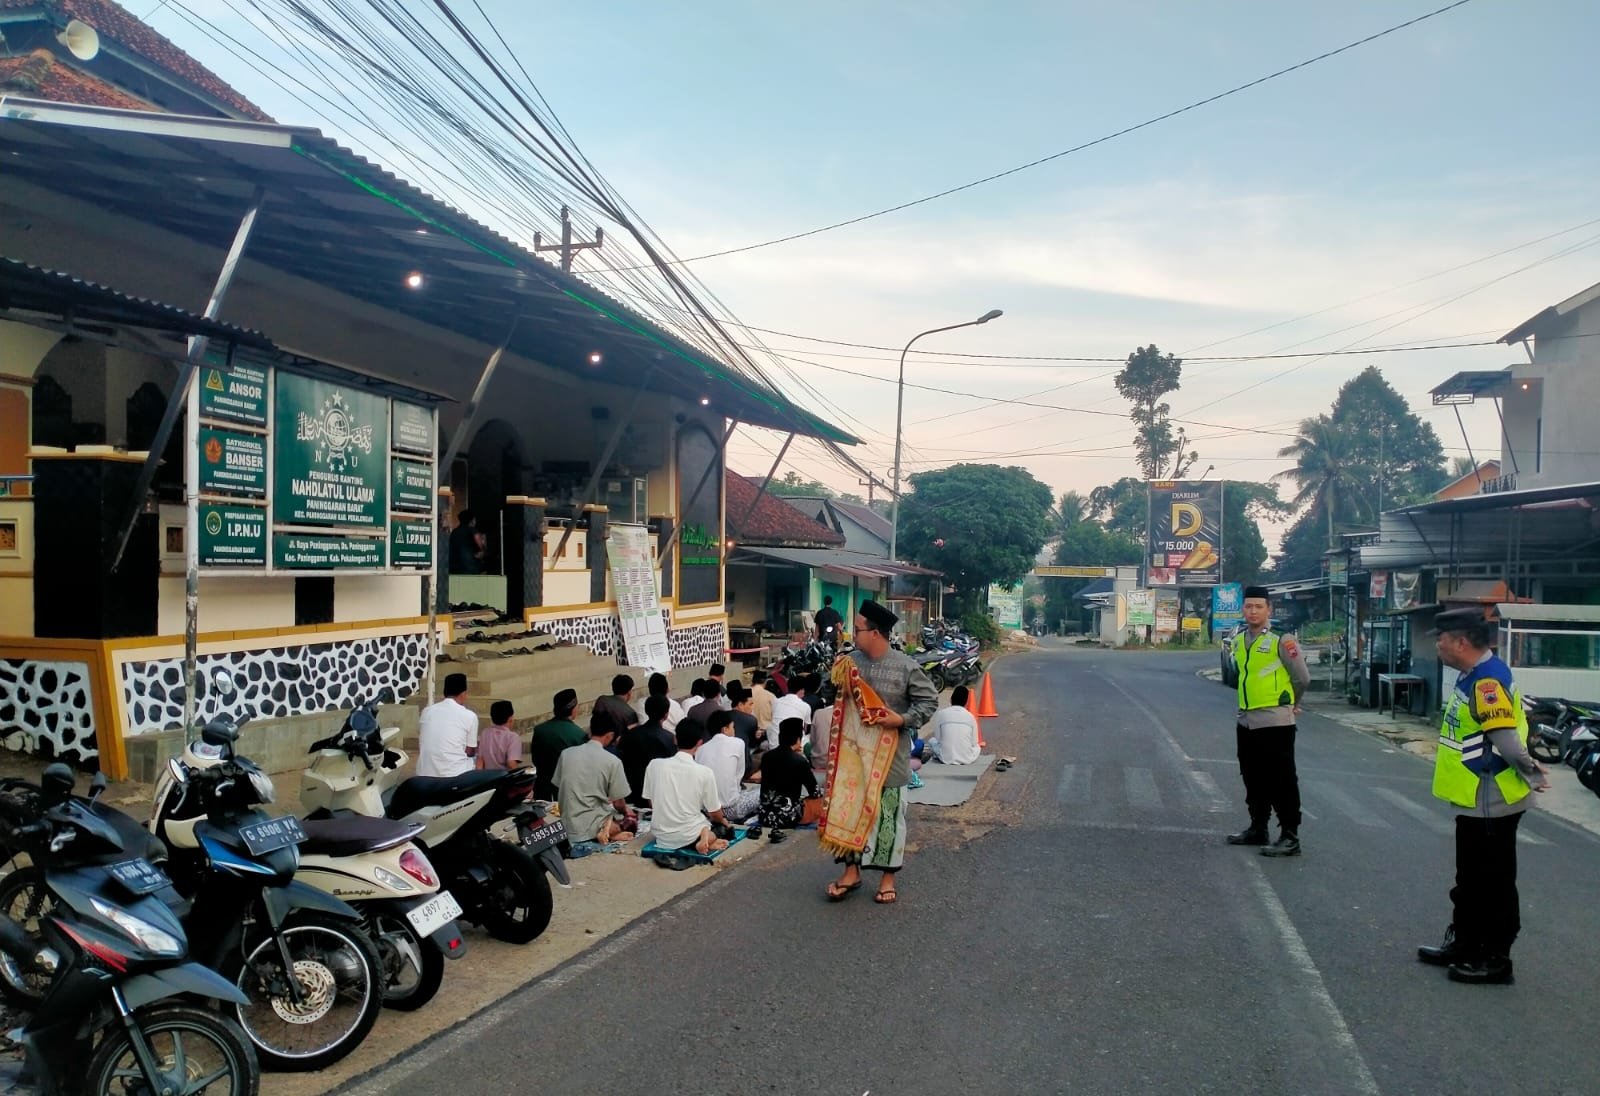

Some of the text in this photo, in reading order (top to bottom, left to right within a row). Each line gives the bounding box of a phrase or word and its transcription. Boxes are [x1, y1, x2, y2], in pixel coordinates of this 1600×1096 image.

[230, 382, 262, 399] ANSOR
[226, 452, 263, 468] BANSER
[315, 450, 358, 467] N U
[309, 470, 339, 482] PENGURUS
[292, 478, 344, 499] NAHDLATUL
[307, 499, 364, 512] PANINGGARAN BARAT
[1171, 501, 1203, 537] D
[228, 523, 260, 537] I.P.N.U
[1165, 541, 1194, 550] 15.000
[246, 831, 255, 840] G
[525, 836, 532, 845] G
[411, 914, 419, 924] G
